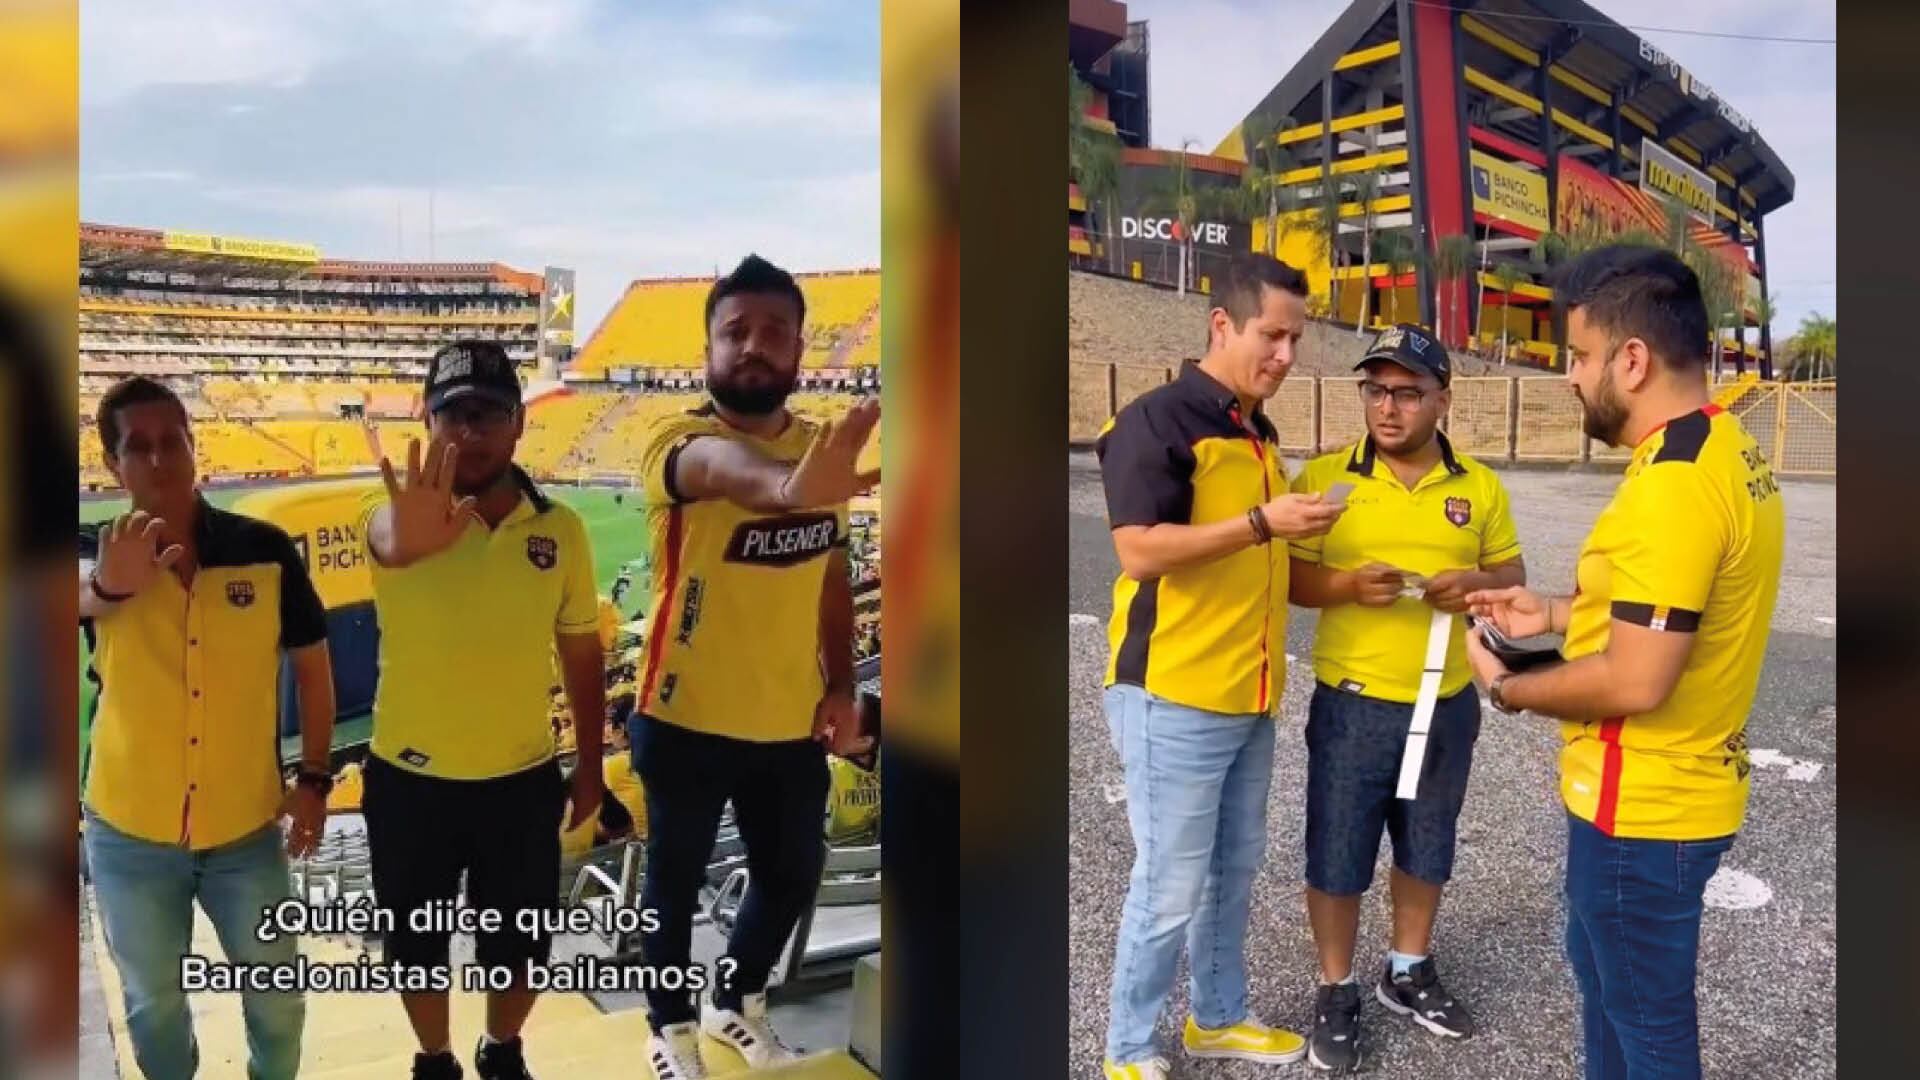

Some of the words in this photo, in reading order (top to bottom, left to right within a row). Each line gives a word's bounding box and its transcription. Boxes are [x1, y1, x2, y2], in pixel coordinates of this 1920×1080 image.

[1494, 172, 1529, 197] BANCO
[1494, 190, 1547, 219] PICHINCHA
[1121, 216, 1230, 246] DISCOVER
[742, 519, 834, 558] PILSENER
